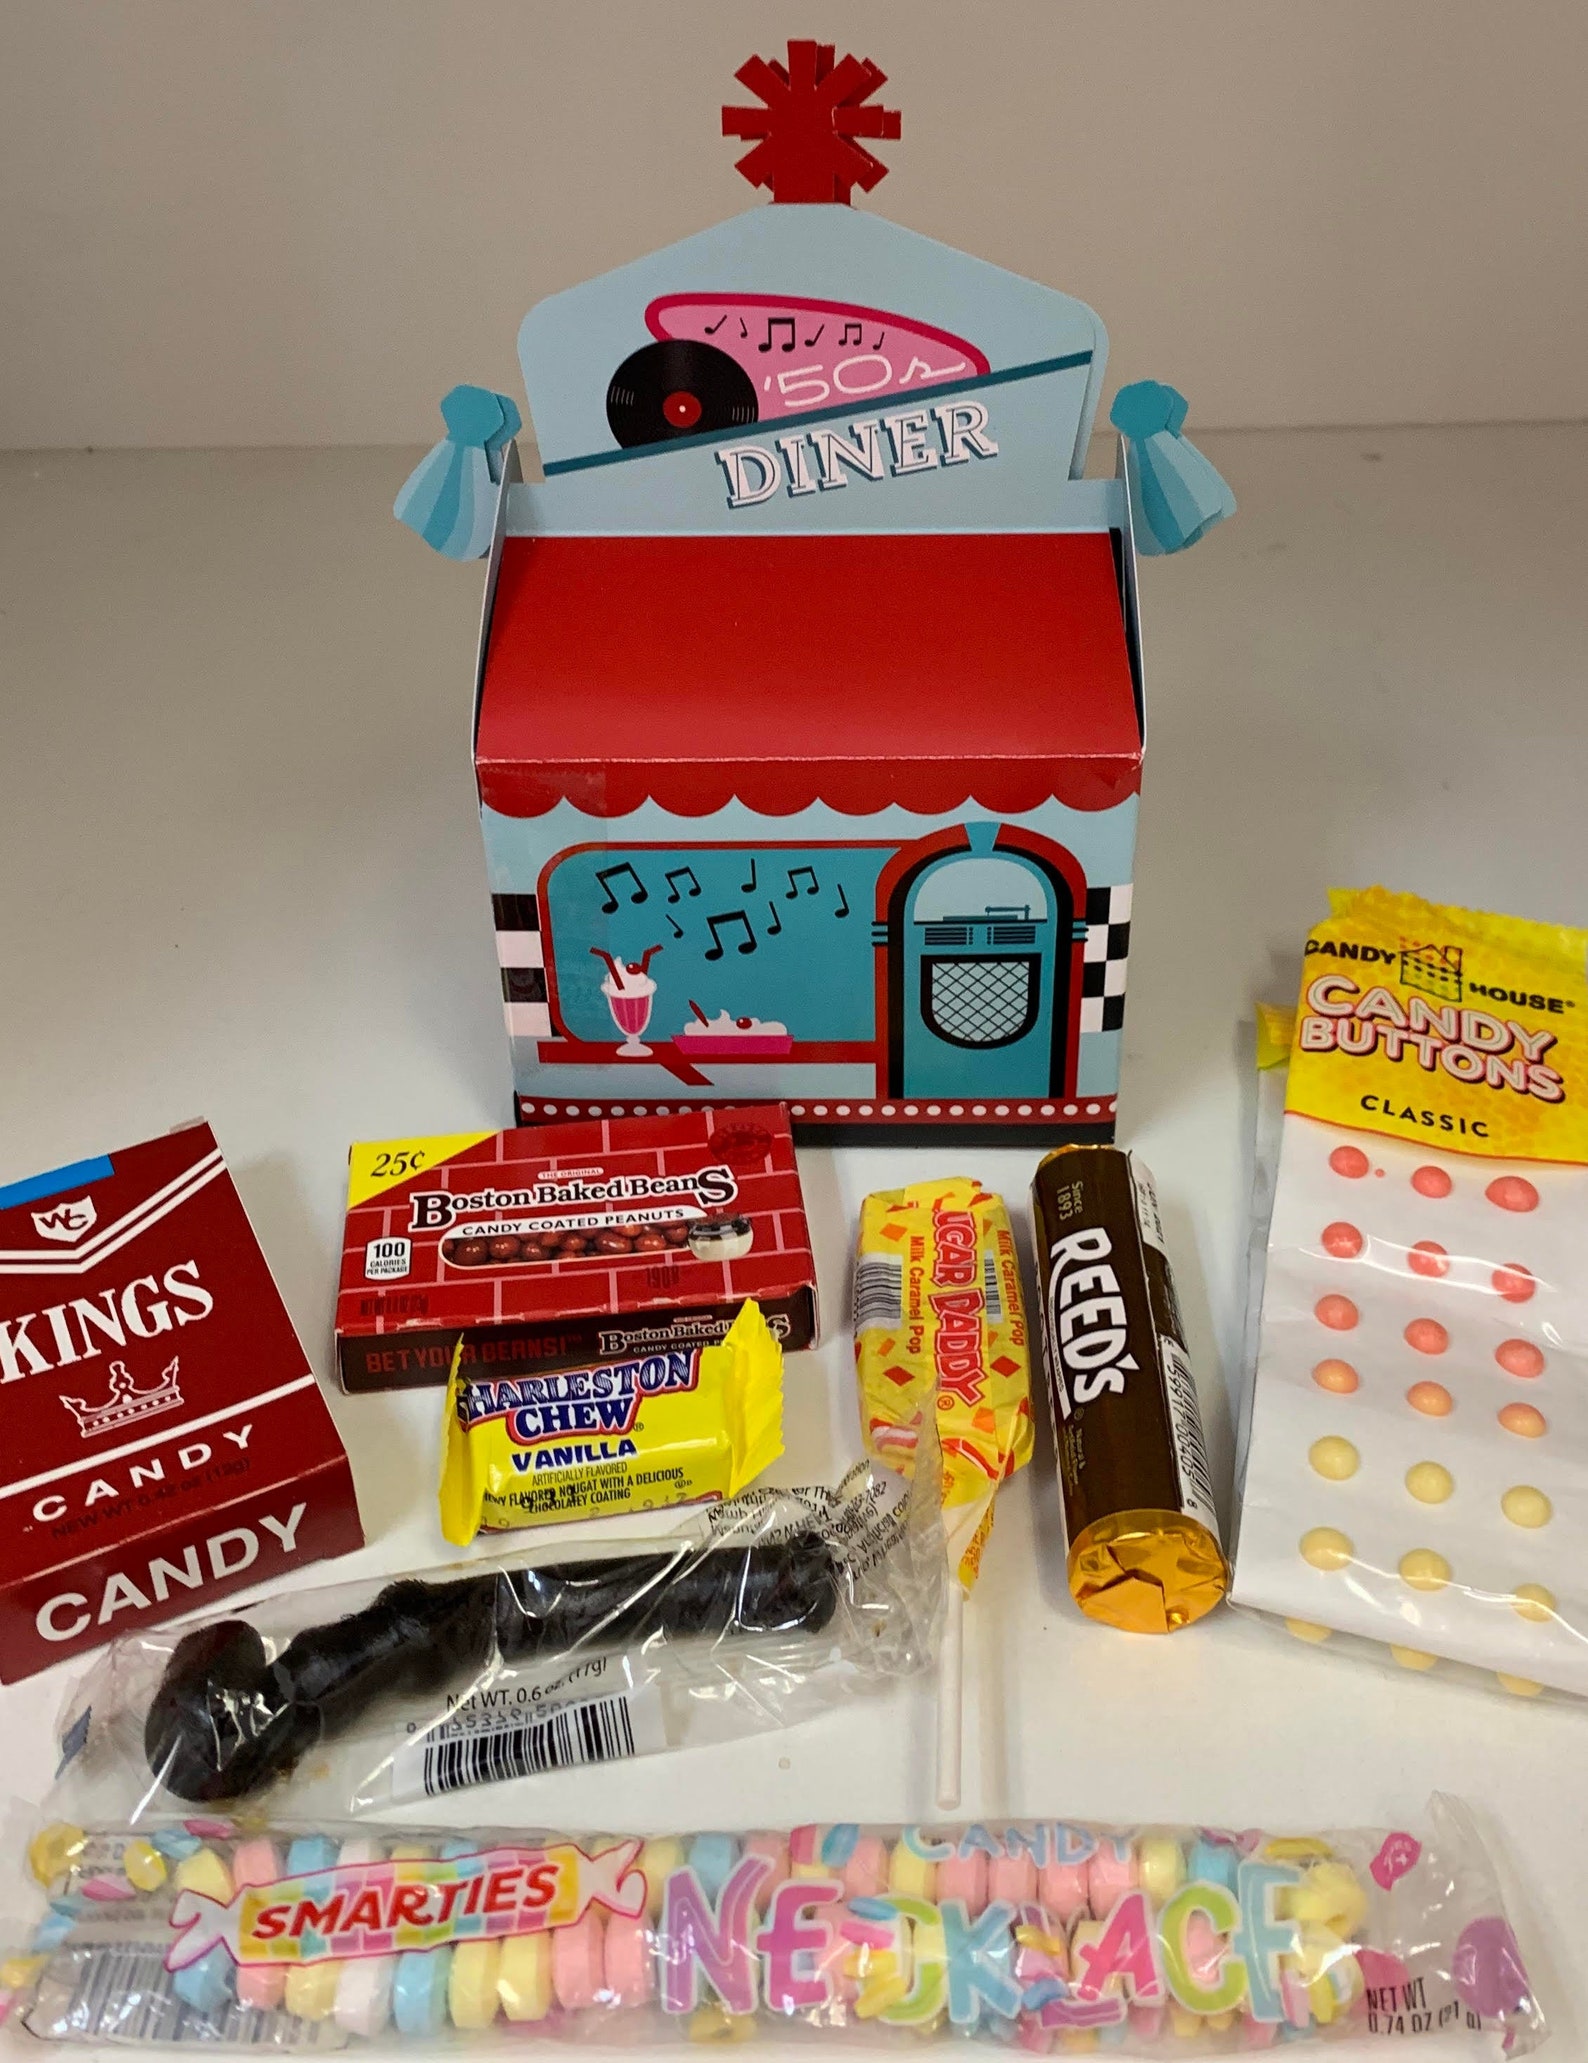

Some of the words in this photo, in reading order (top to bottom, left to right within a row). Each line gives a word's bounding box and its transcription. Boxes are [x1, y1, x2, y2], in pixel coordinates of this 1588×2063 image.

[764, 354, 966, 407] '50s
[714, 400, 999, 510] DINER
[1305, 940, 1396, 965] CANDY
[1305, 974, 1557, 1062] CANDY
[1300, 1015, 1565, 1104] BUTTONS
[1360, 1095, 1490, 1137] CLASSIC
[370, 1150, 425, 1177] 25¢
[541, 1170, 559, 1179] THE
[560, 1167, 602, 1178] ORIGINAL
[411, 1190, 531, 1230] Boston
[537, 1176, 625, 1204] Baked
[1056, 1186, 1073, 1221] 1893
[1071, 1180, 1084, 1214] Since
[462, 1222, 522, 1237] CANDY
[529, 1216, 598, 1231] COATED
[605, 1207, 684, 1226] PEANUTS
[373, 1242, 406, 1260] 100
[909, 1235, 925, 1263] Milk
[932, 1208, 978, 1288] UGAR
[997, 1230, 1011, 1257] Milk
[366, 1266, 379, 1275] PER
[380, 1265, 408, 1275] PACKAGE
[370, 1258, 406, 1268] CALORIES
[908, 1267, 925, 1321] Caramel
[1001, 1260, 1019, 1314] Caramel
[0, 1260, 213, 1384] KINGS
[1008, 1316, 1025, 1347] Pop
[1050, 1227, 1140, 1404] REED'S
[600, 1328, 670, 1354] Boston
[673, 1320, 723, 1338] Baked
[633, 1344, 667, 1354] CANDY
[671, 1340, 708, 1351] COATED
[907, 1325, 925, 1354] Pop
[366, 1350, 409, 1374] BET
[457, 1351, 697, 1421] HARLESTON
[512, 1438, 638, 1472] VANILLA
[32, 1424, 253, 1522] CANDY
[531, 1468, 584, 1487] ARTIFICIALLY
[586, 1461, 628, 1478] FLAVORED
[559, 1480, 597, 1500] NOUGAT
[599, 1475, 626, 1490] WITH
[627, 1473, 635, 1487] A
[636, 1467, 684, 1485] DELICIOUS
[590, 1487, 632, 1505] COATING
[35, 1502, 307, 1642] CANDY
[480, 1687, 513, 1708] WT.
[516, 1685, 542, 1704] 0.6
[901, 1822, 1136, 1868] CANDY
[251, 1863, 560, 1941] SMARTIES
[1366, 1986, 1397, 2013] NET
[1402, 1976, 1426, 2012] WT
[1368, 2011, 1405, 2035] 0.74
[1411, 2011, 1432, 2034] OZ
